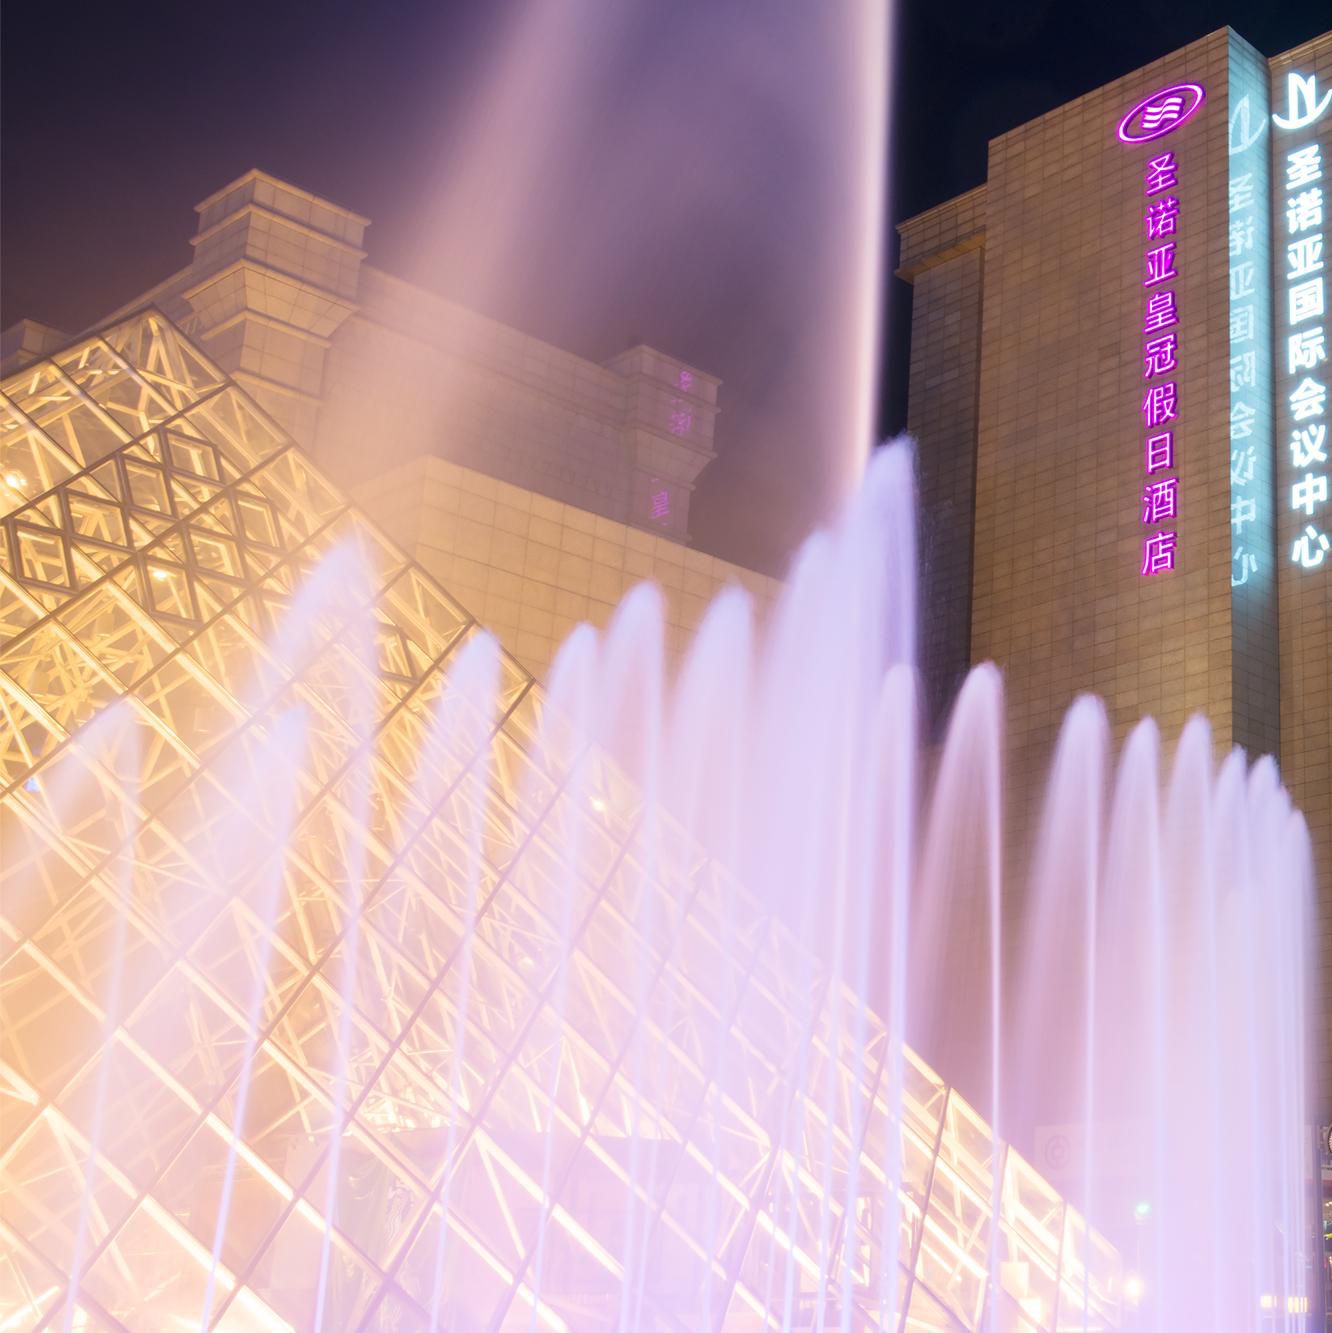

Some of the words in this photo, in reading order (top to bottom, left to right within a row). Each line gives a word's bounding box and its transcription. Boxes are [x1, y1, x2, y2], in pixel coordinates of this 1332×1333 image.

[1141, 152, 1179, 576] 圣诺亚皇冠假日酒店
[1285, 144, 1330, 569] 圣诺亚国际会议中心
